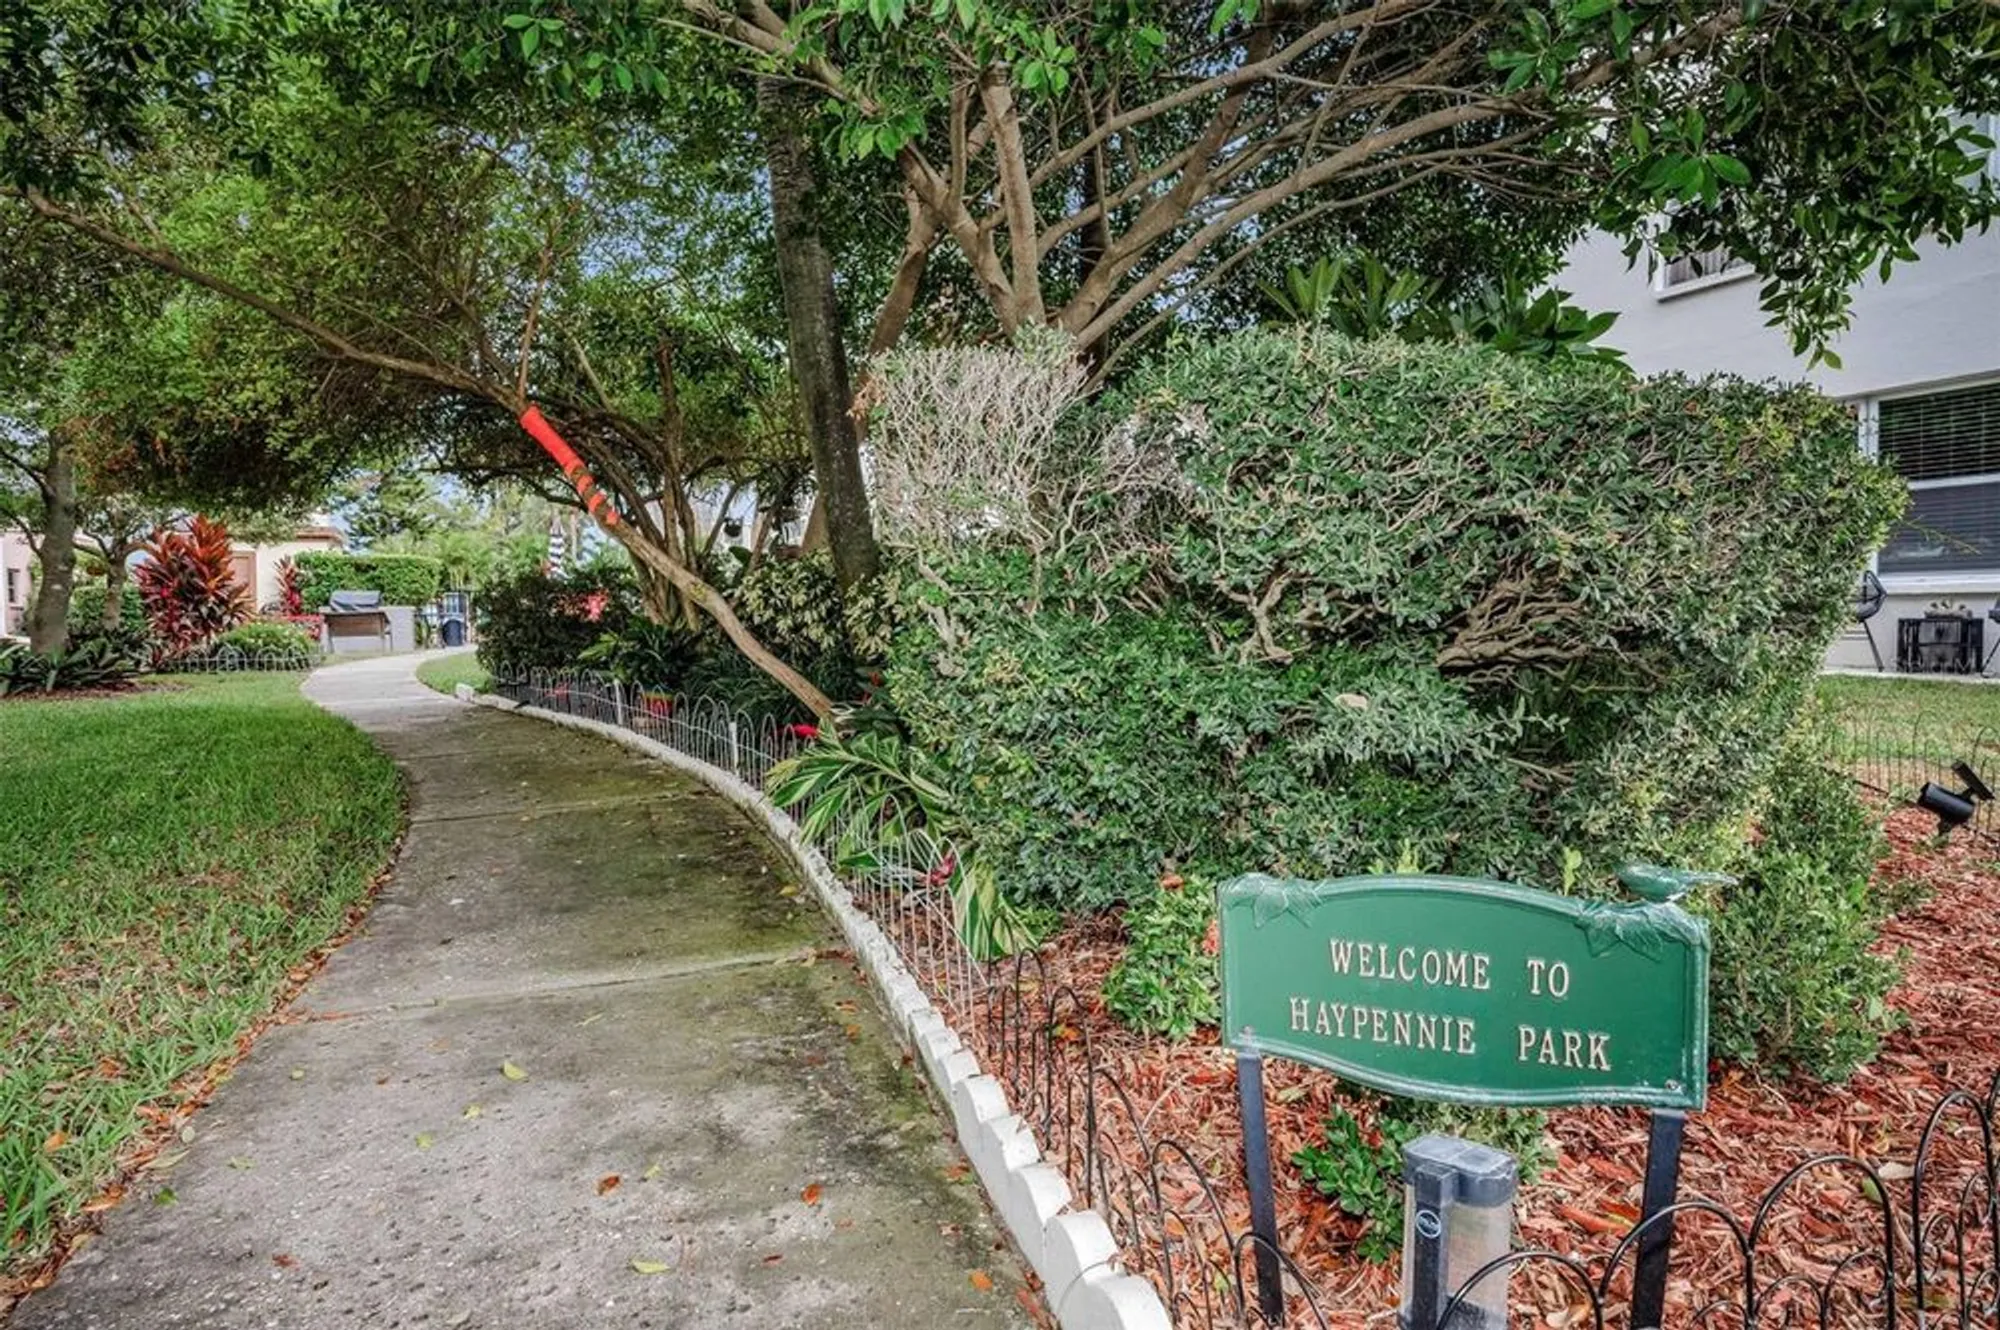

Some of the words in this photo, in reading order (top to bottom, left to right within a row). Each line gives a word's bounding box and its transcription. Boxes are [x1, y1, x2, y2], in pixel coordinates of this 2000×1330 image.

[1329, 938, 1491, 991] WELCOME
[1526, 957, 1571, 998] TO
[1288, 996, 1477, 1055] HAYPENNIE
[1517, 1024, 1612, 1071] PARK
